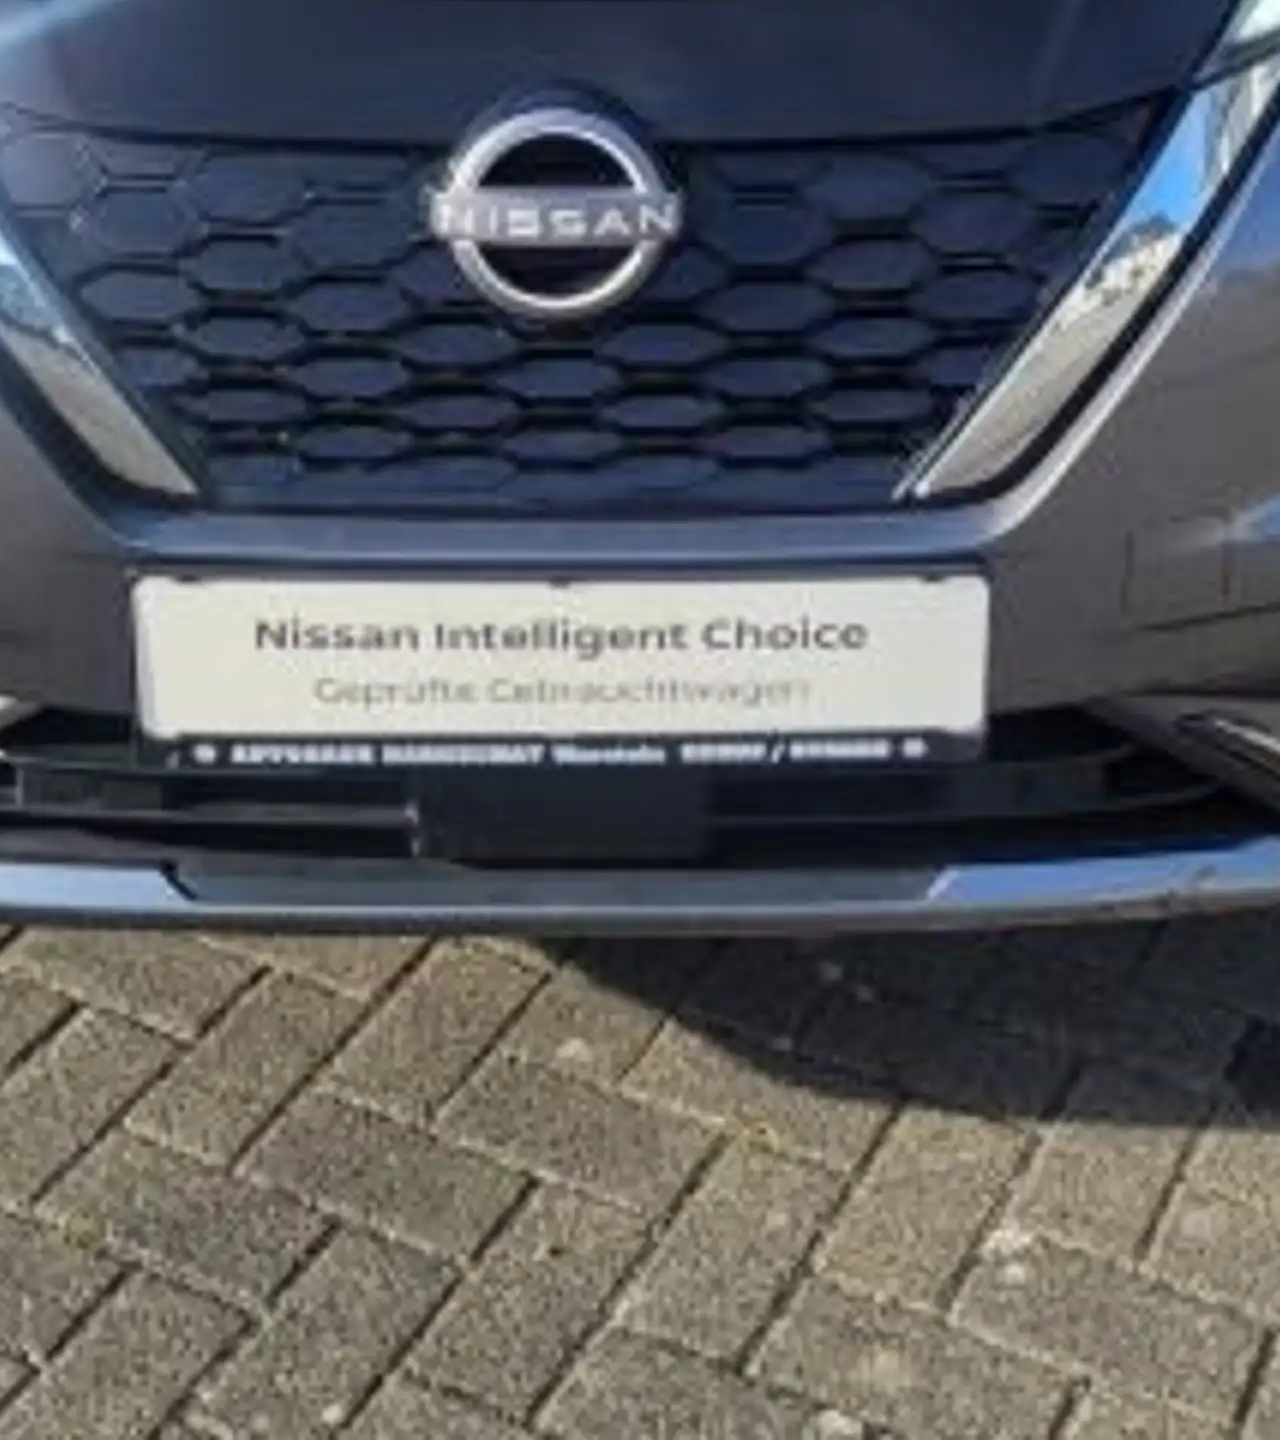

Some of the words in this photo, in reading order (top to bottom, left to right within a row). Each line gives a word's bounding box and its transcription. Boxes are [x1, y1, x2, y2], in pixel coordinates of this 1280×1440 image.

[434, 199, 674, 237] NISSAN
[255, 614, 420, 650] Nissan
[434, 614, 688, 661] Intelligent
[701, 612, 869, 651] Choice
